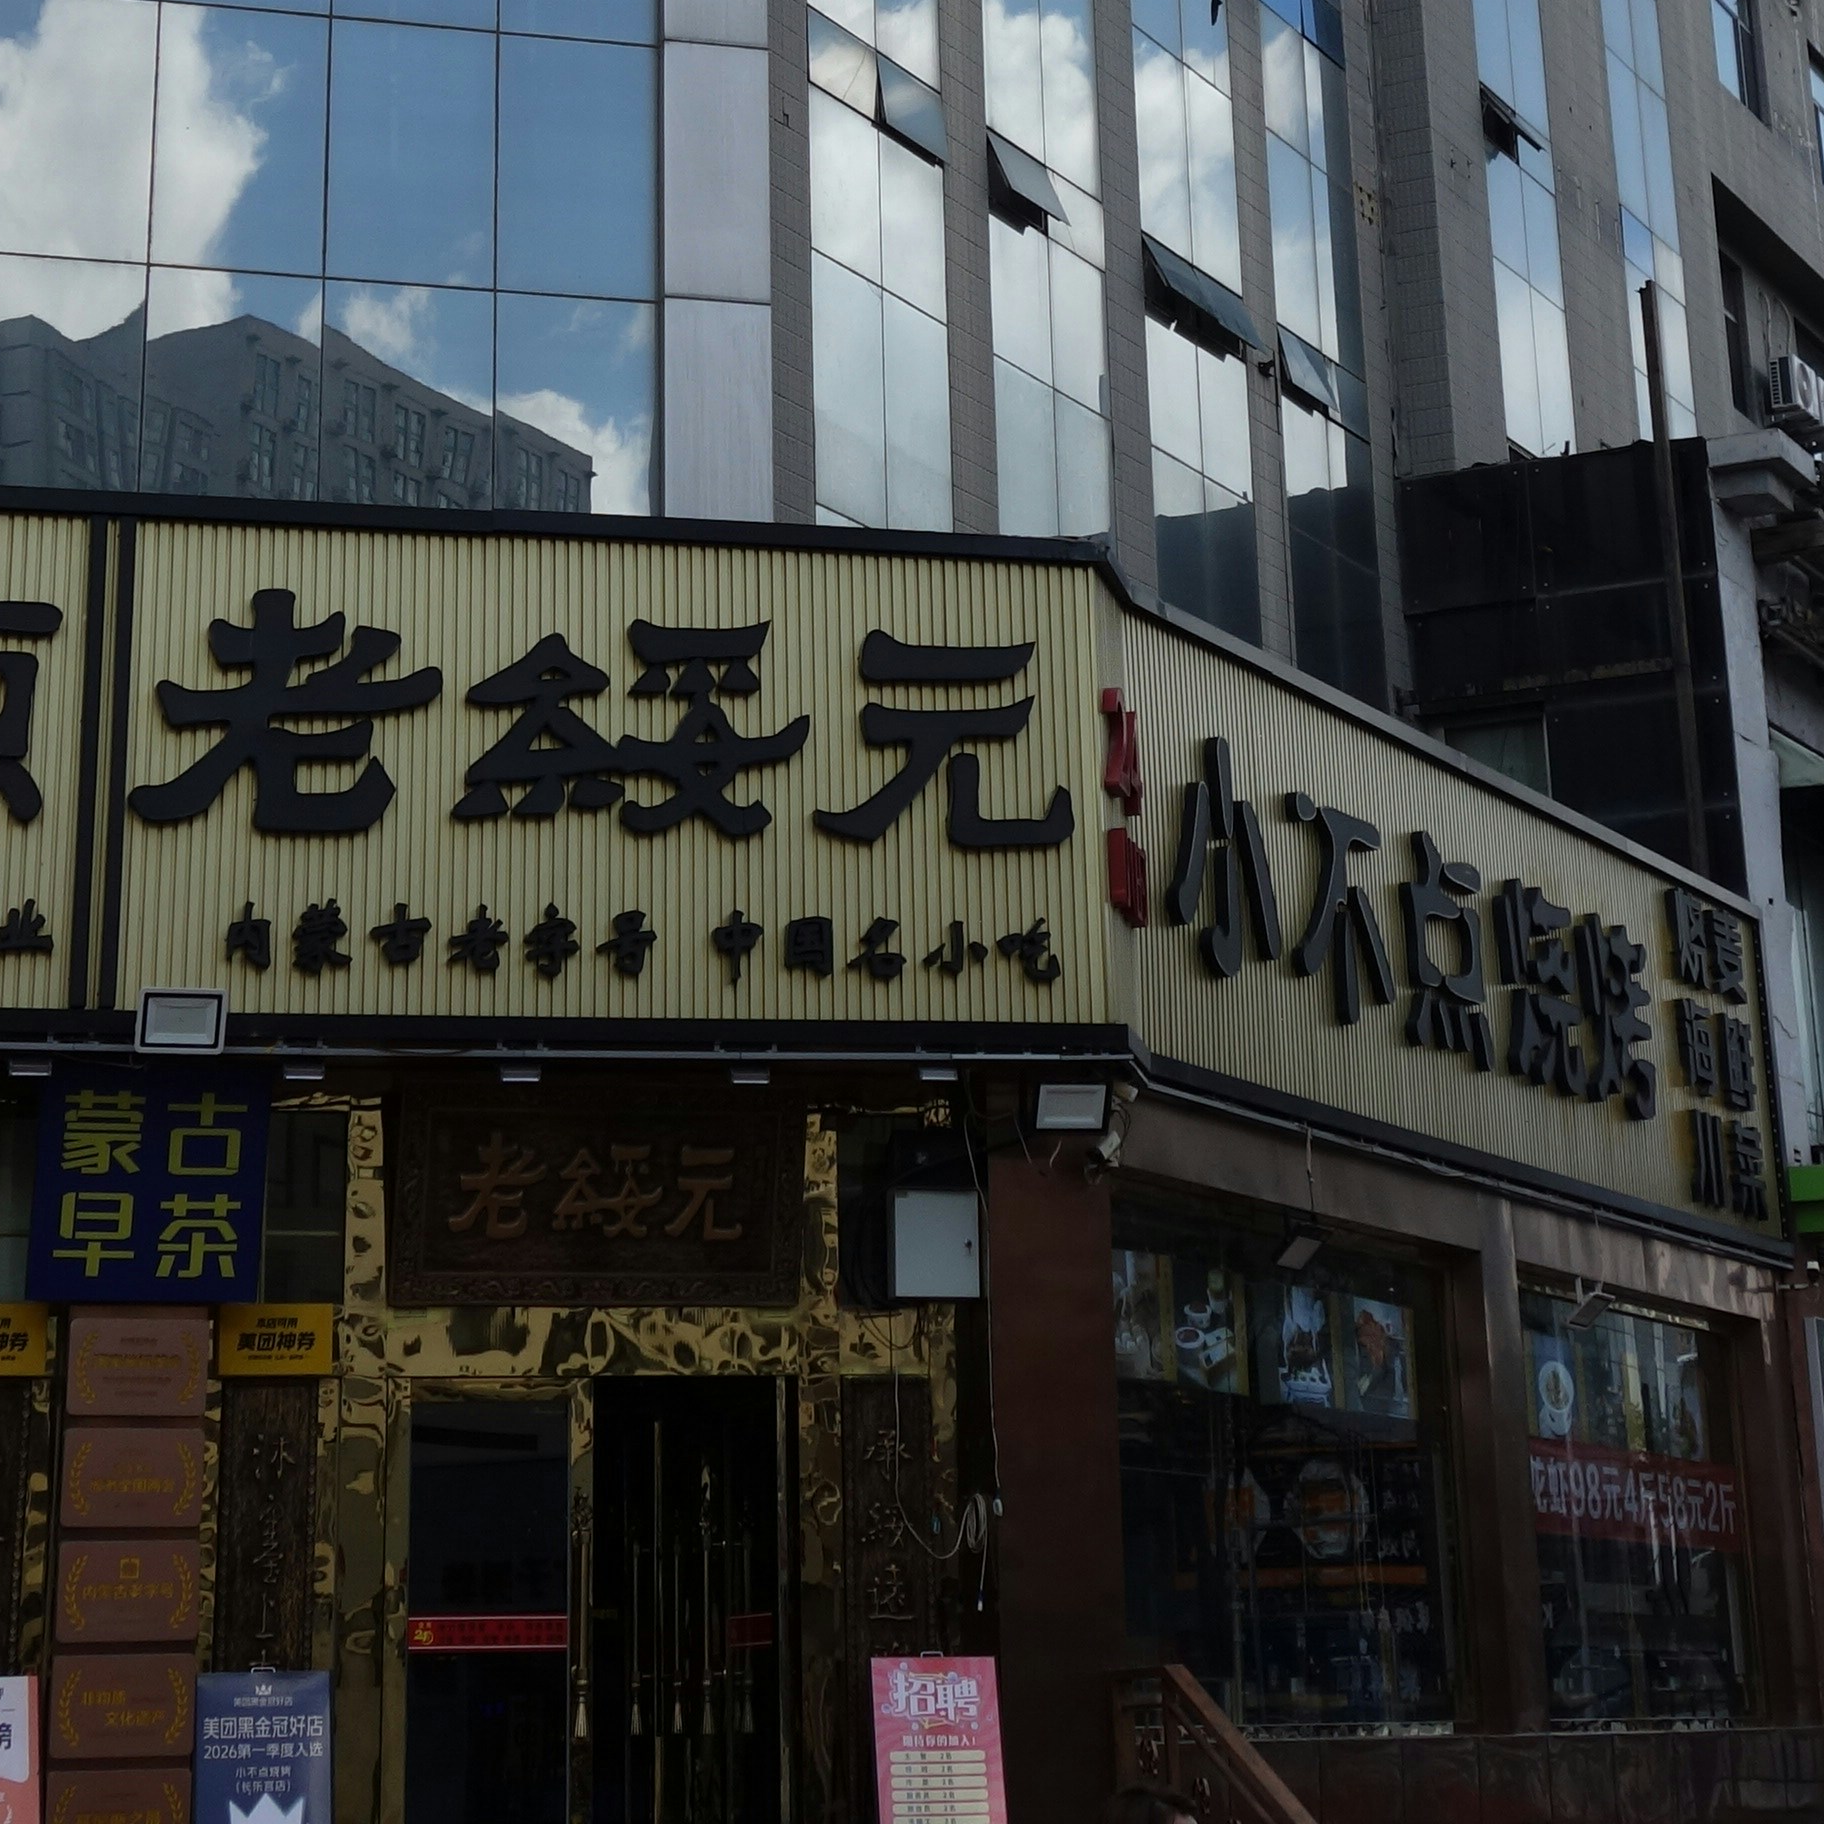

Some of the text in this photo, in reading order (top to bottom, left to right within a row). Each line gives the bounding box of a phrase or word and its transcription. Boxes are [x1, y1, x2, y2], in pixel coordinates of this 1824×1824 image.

[224, 898, 1061, 984] 内蒙古老字号 中国名小吃
[1164, 736, 1658, 1121] 小不点烧烤
[60, 1089, 249, 1176] 蒙古
[52, 1190, 243, 1280] 早茶
[237, 1331, 316, 1352] 美团神券
[890, 1668, 980, 1723] 招聘
[203, 1714, 324, 1740] 美团黑金冠好店
[203, 1740, 324, 1760] 2026第一季度入选
[235, 1765, 292, 1779] 小不点烧烤
